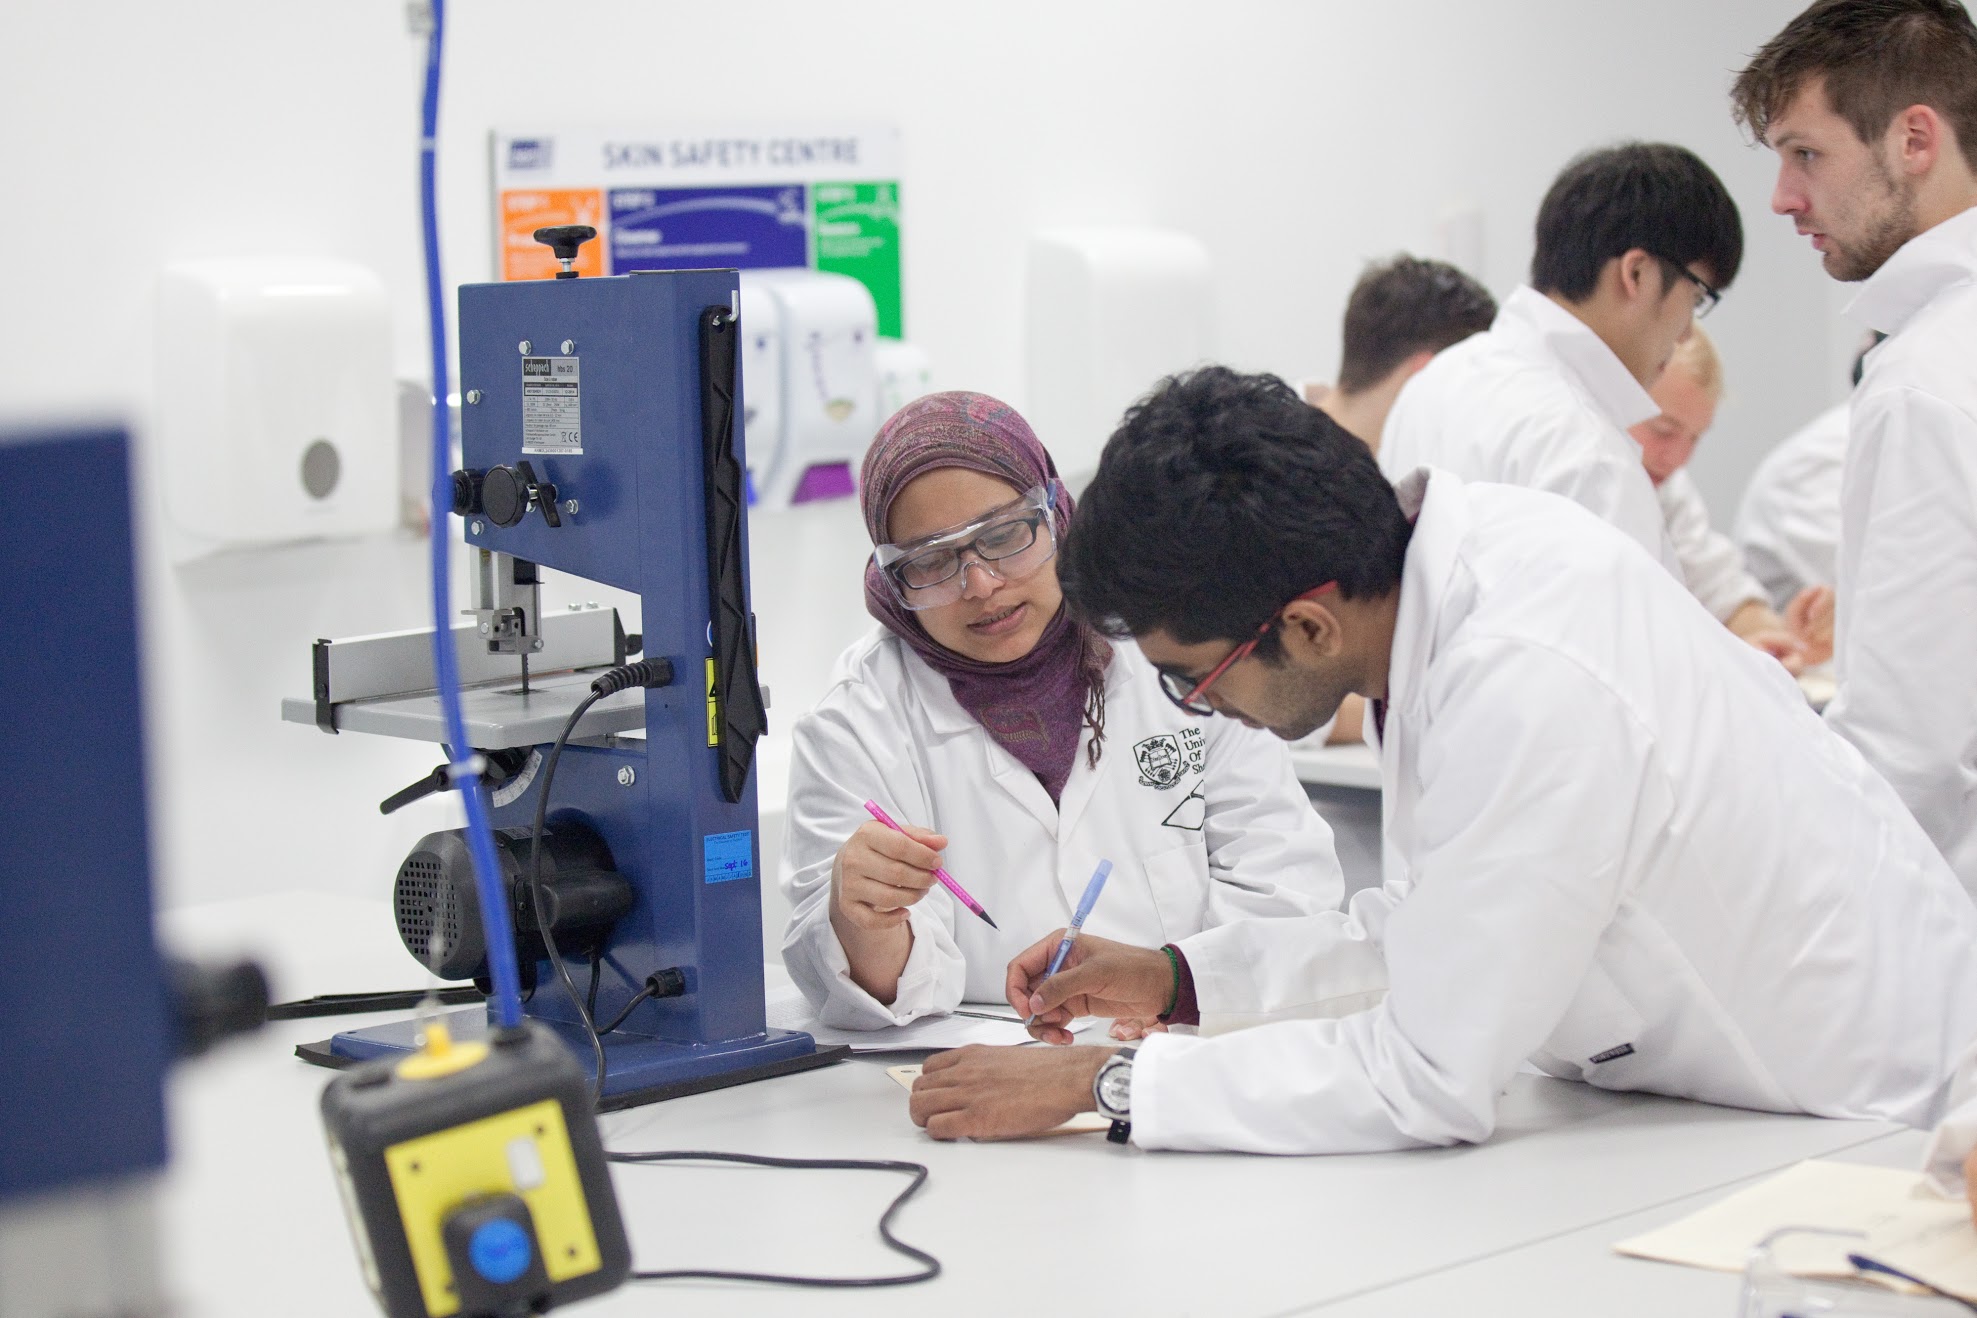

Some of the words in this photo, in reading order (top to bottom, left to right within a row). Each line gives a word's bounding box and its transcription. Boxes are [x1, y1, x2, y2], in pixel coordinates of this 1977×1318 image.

[602, 140, 663, 170] SKIN
[670, 138, 760, 168] SAFETY
[767, 136, 860, 166] CENTRE
[525, 359, 549, 376] scheppach
[1179, 728, 1201, 739] The
[1189, 750, 1202, 763] Of
[741, 859, 748, 867] 16
